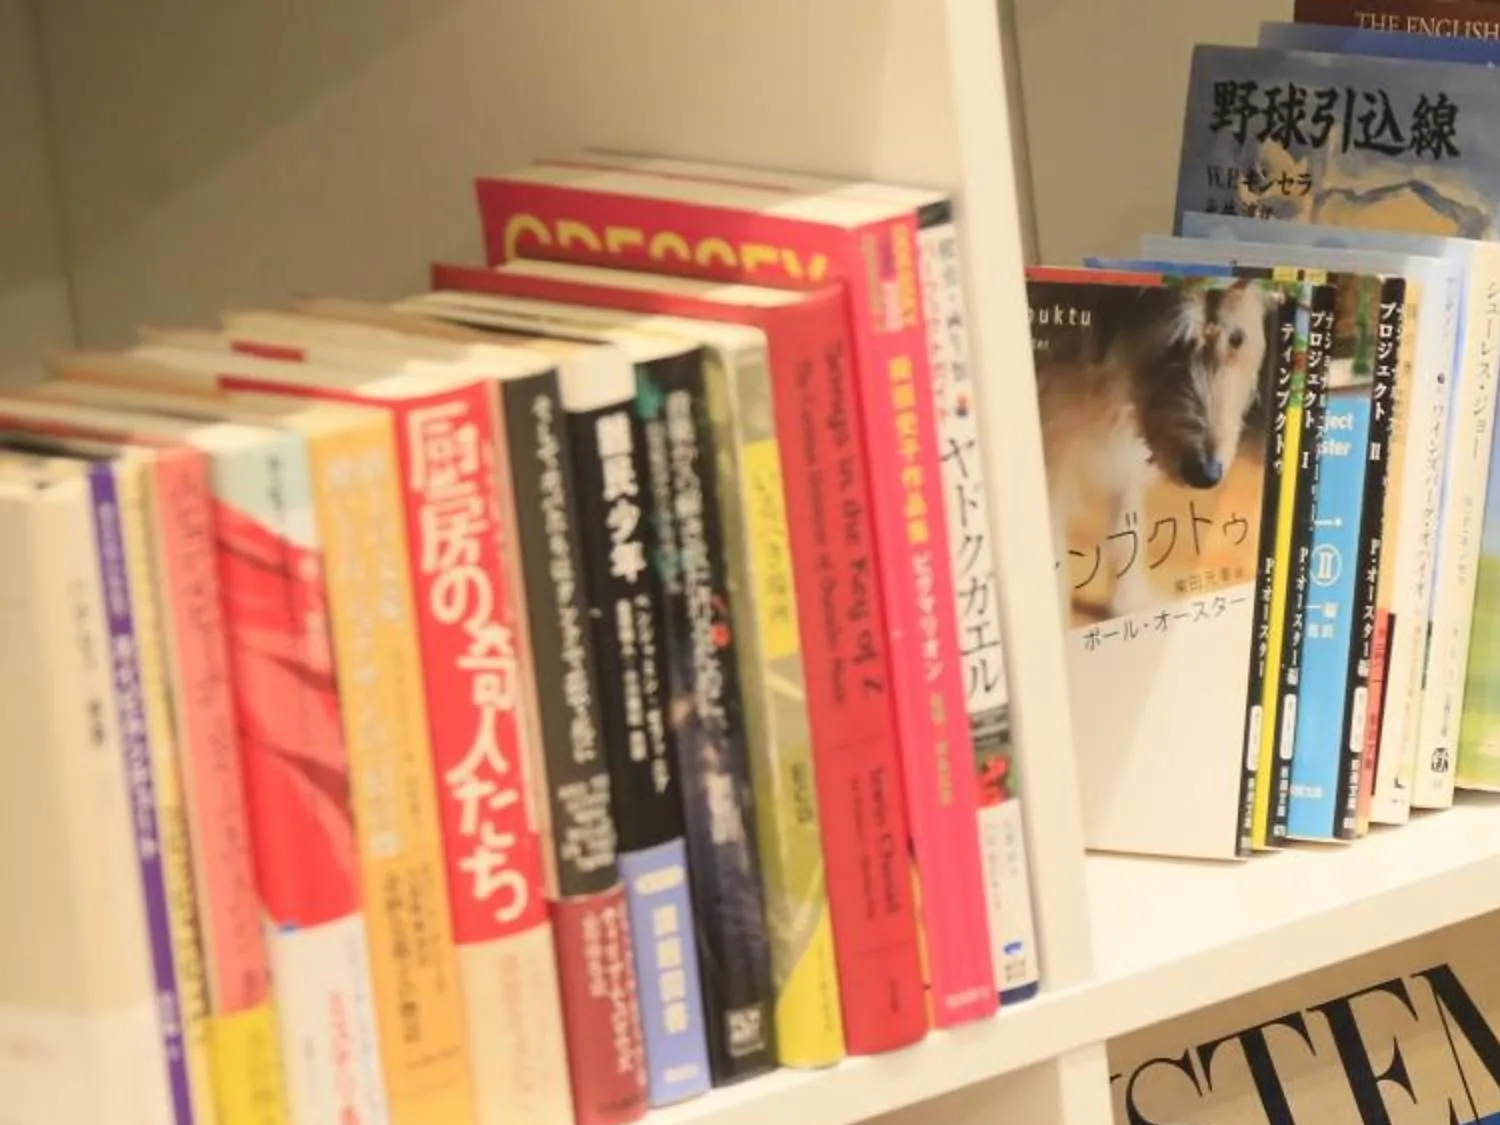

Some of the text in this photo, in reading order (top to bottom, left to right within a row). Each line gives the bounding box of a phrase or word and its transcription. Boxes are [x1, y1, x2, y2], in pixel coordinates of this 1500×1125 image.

[1354, 11, 1402, 33] THE
[1405, 16, 1500, 42] ENGLISH
[1208, 78, 1462, 160] 野球引込線
[1317, 442, 1351, 458] ster
[1324, 413, 1354, 432] ject
[940, 436, 1000, 700] ヤドクガエル
[1056, 500, 1251, 590] ンブクトゥ
[1083, 596, 1249, 652] ポール・オースター
[406, 400, 529, 922] 厨房の奇人たち
